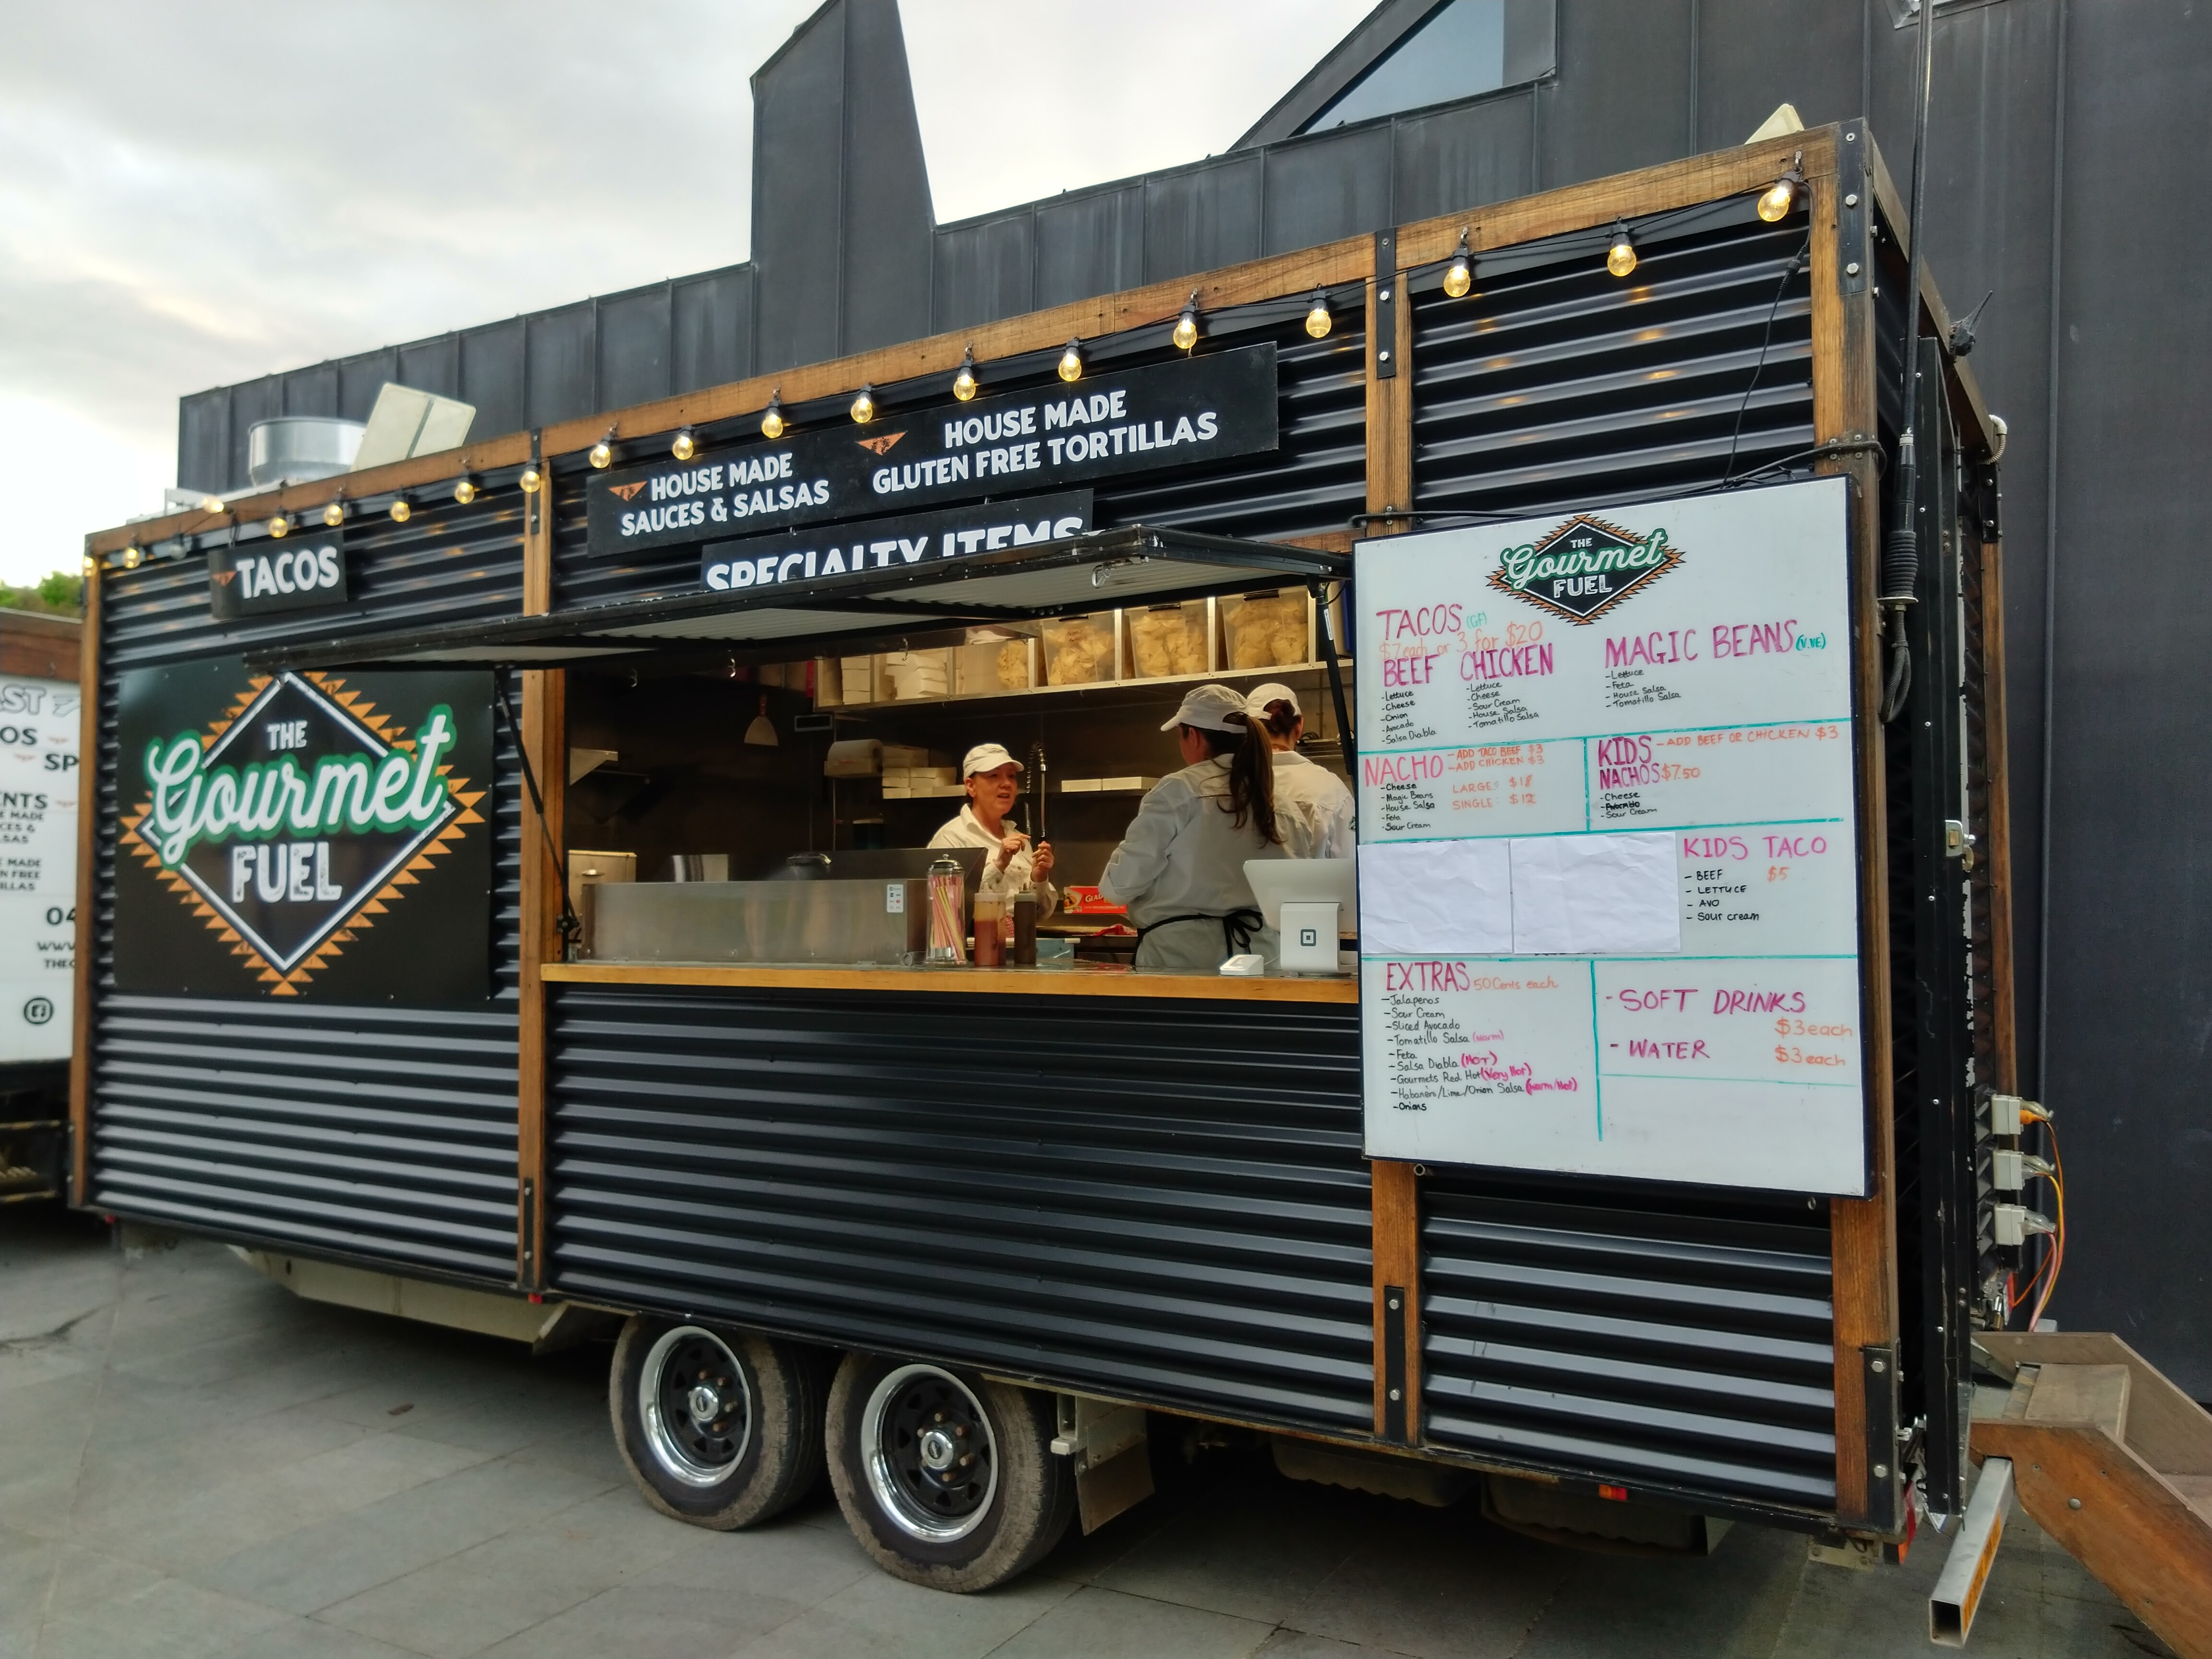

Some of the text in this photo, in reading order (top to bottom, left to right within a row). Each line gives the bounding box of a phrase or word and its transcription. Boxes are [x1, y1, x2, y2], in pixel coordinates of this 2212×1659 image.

[945, 390, 1127, 448] HOUSE MADE
[872, 412, 1218, 494] GLUTEN FREE TORTILLAS
[651, 453, 793, 501] HOUSE MADE
[621, 480, 830, 536] SAUCES & SALSAS
[1571, 538, 1592, 548] THE
[236, 546, 339, 599] TACOS
[1503, 532, 1664, 589] Gourmet
[1553, 575, 1612, 598] FUEL
[1376, 604, 1462, 640] TACOS
[1456, 631, 1467, 652] 3
[1475, 628, 1499, 651] for
[1505, 621, 1542, 648] $20
[1605, 629, 1698, 668] MAGIC
[1713, 619, 1797, 659] BEANS
[1384, 643, 1553, 686] BEEF CHICKEN
[0, 683, 47, 715] ST
[267, 720, 308, 750] THE
[1598, 735, 1652, 767] KIDS
[1697, 733, 1724, 745] BEEF
[1730, 732, 1743, 743] OR
[1815, 726, 1838, 741] $3
[1364, 755, 1443, 787] NACHO
[1478, 747, 1497, 757] TACO
[1500, 745, 1521, 757] BEEF
[1528, 744, 1543, 755] $3
[1528, 756, 1544, 764] $3
[148, 714, 451, 865] Gourmet
[1509, 775, 1532, 788] $18
[1600, 762, 1700, 790] NACHOS $7.50
[0, 792, 47, 809] NTS
[1683, 836, 1827, 860] KIDS TACO
[232, 841, 342, 903] FUEL
[1696, 866, 1790, 883] BEEF $5
[1697, 912, 1722, 921] Sour
[1699, 899, 1719, 907] AVO
[1386, 962, 1470, 991] EXTRAS
[1526, 975, 1559, 988] each
[1417, 1007, 1444, 1018] Cream
[1619, 988, 1806, 1015] SOFT DRINKS
[1424, 1019, 1460, 1030] Avocado
[1443, 1032, 1470, 1043] Salsa
[1429, 1056, 1459, 1069] Diabla
[1630, 1039, 1709, 1058] WATER
[1443, 1071, 1462, 1082] Red
[1466, 1070, 1481, 1080] Hot
[1497, 1082, 1525, 1093] Salsa
